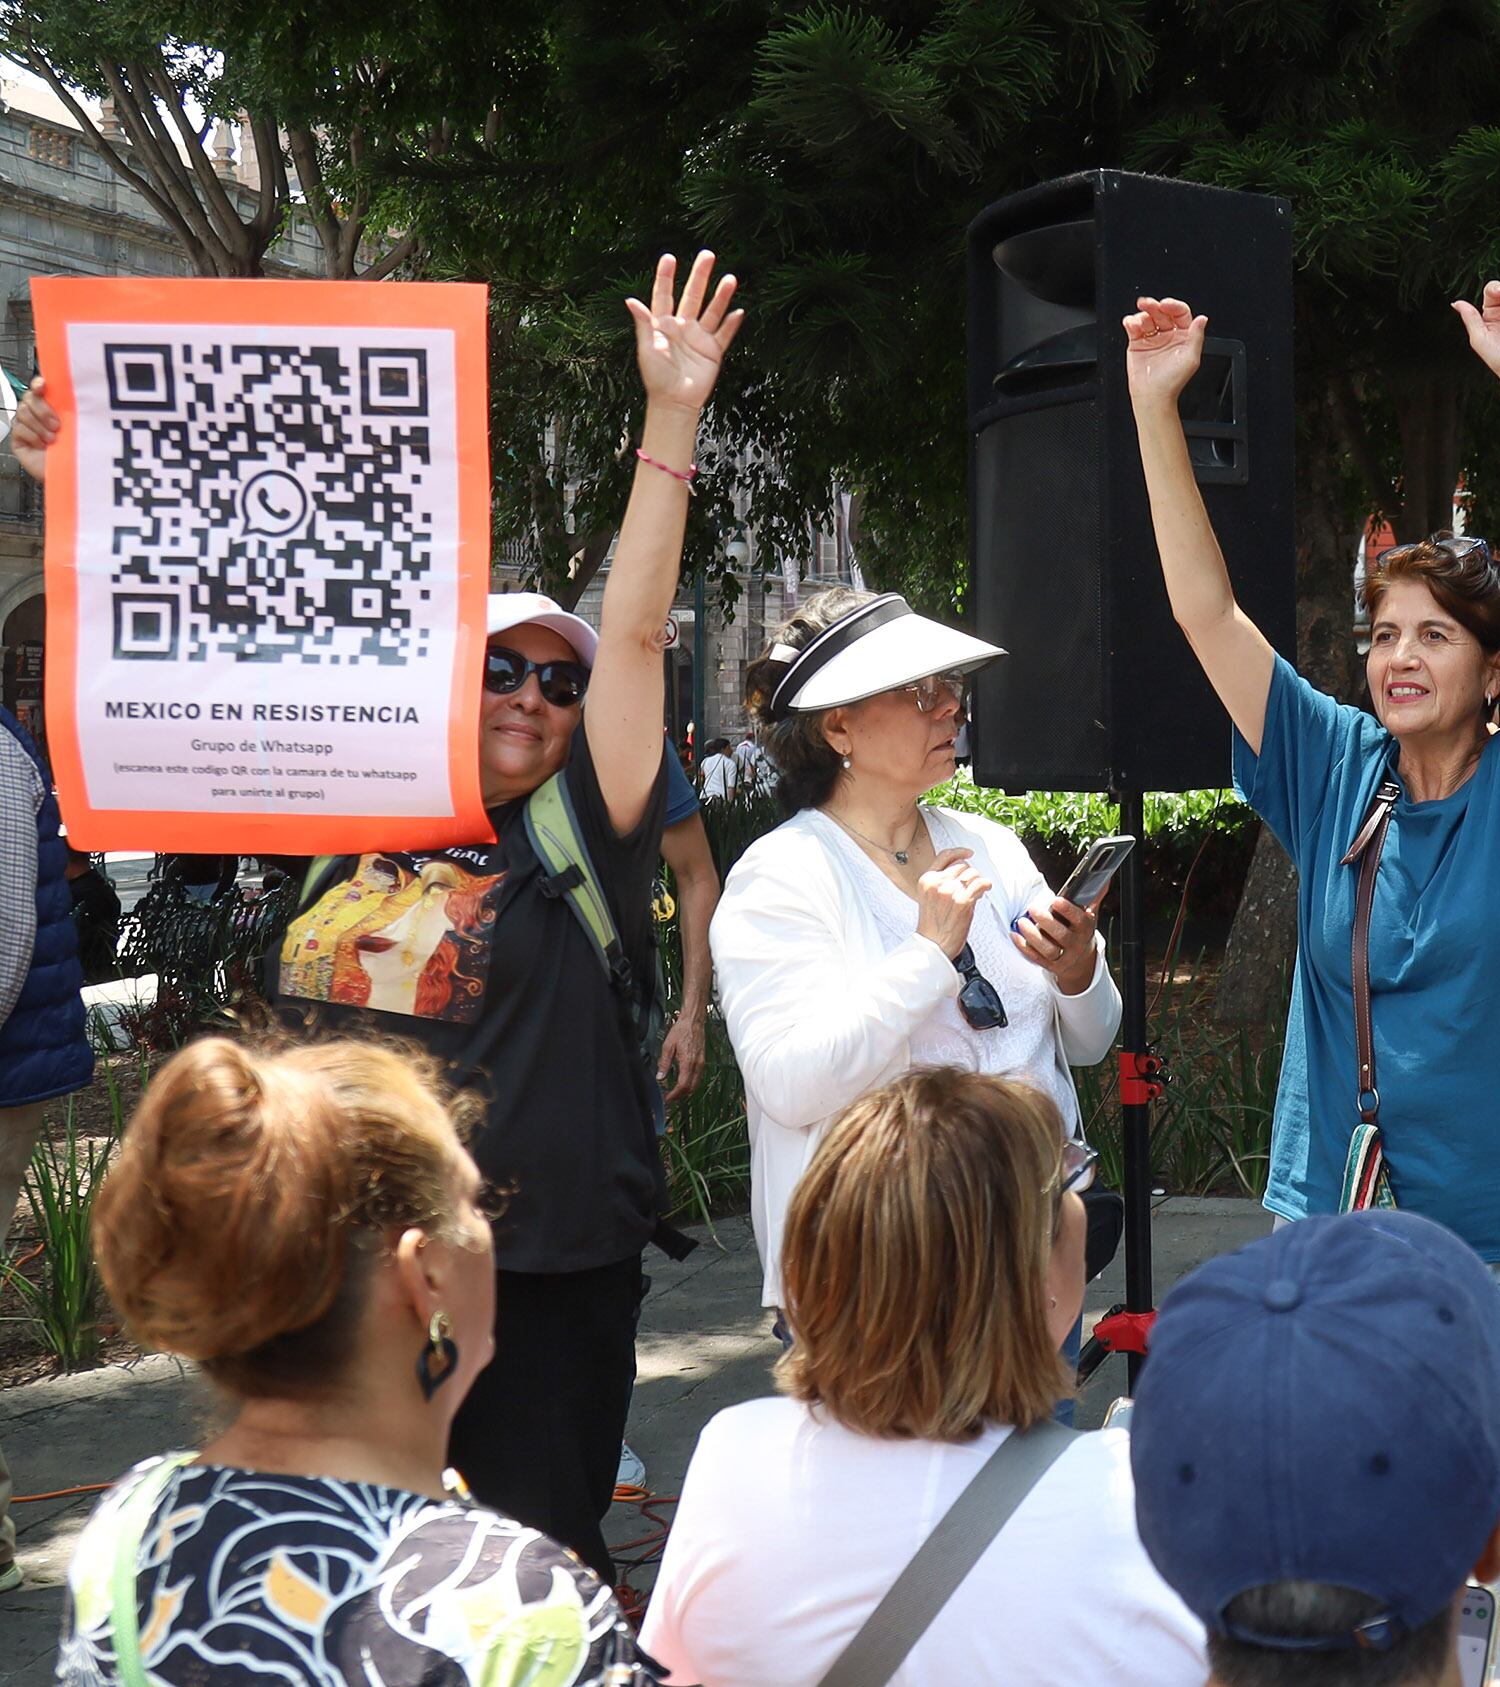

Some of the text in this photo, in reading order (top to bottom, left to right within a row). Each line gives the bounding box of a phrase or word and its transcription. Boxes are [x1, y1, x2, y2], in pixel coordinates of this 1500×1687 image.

[105, 702, 419, 724] MEXICO EN RESISTENCIA
[191, 739, 334, 756] Grupo de Whatsapp
[113, 763, 418, 782] (escanea este codigo QR con la camara de tu whatsapp
[211, 787, 325, 800] para unirte al grupo)
